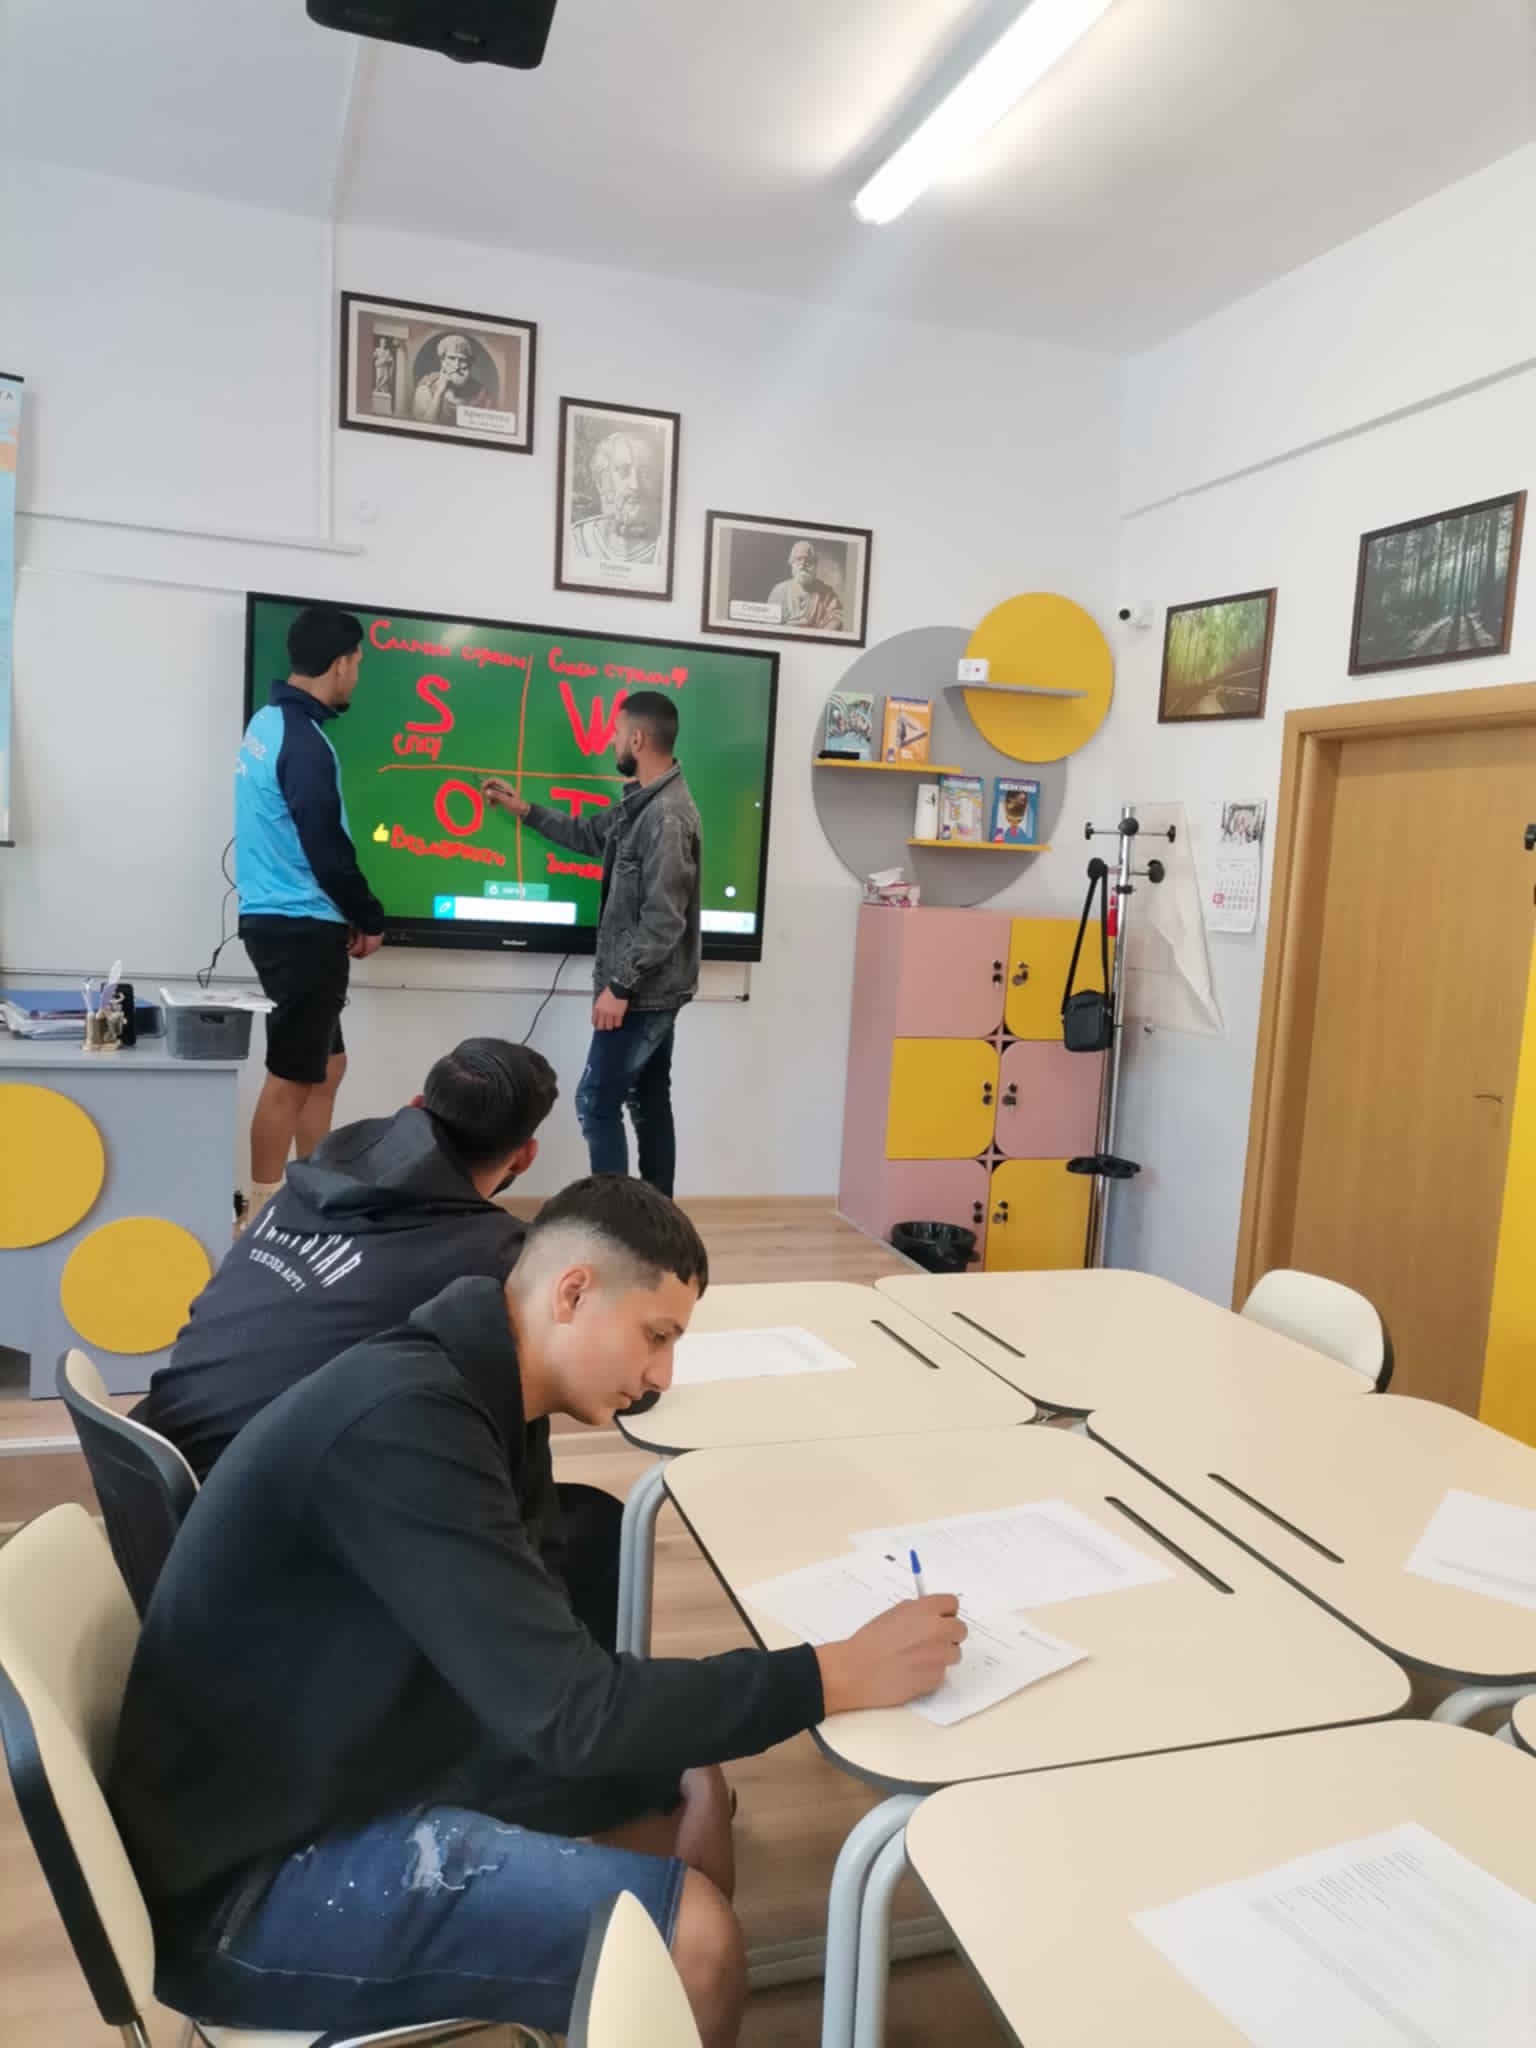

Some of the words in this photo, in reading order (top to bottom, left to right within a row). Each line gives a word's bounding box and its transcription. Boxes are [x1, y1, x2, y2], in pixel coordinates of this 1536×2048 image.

[405, 674, 454, 734] S
[558, 681, 629, 757] W
[434, 779, 484, 837] O
